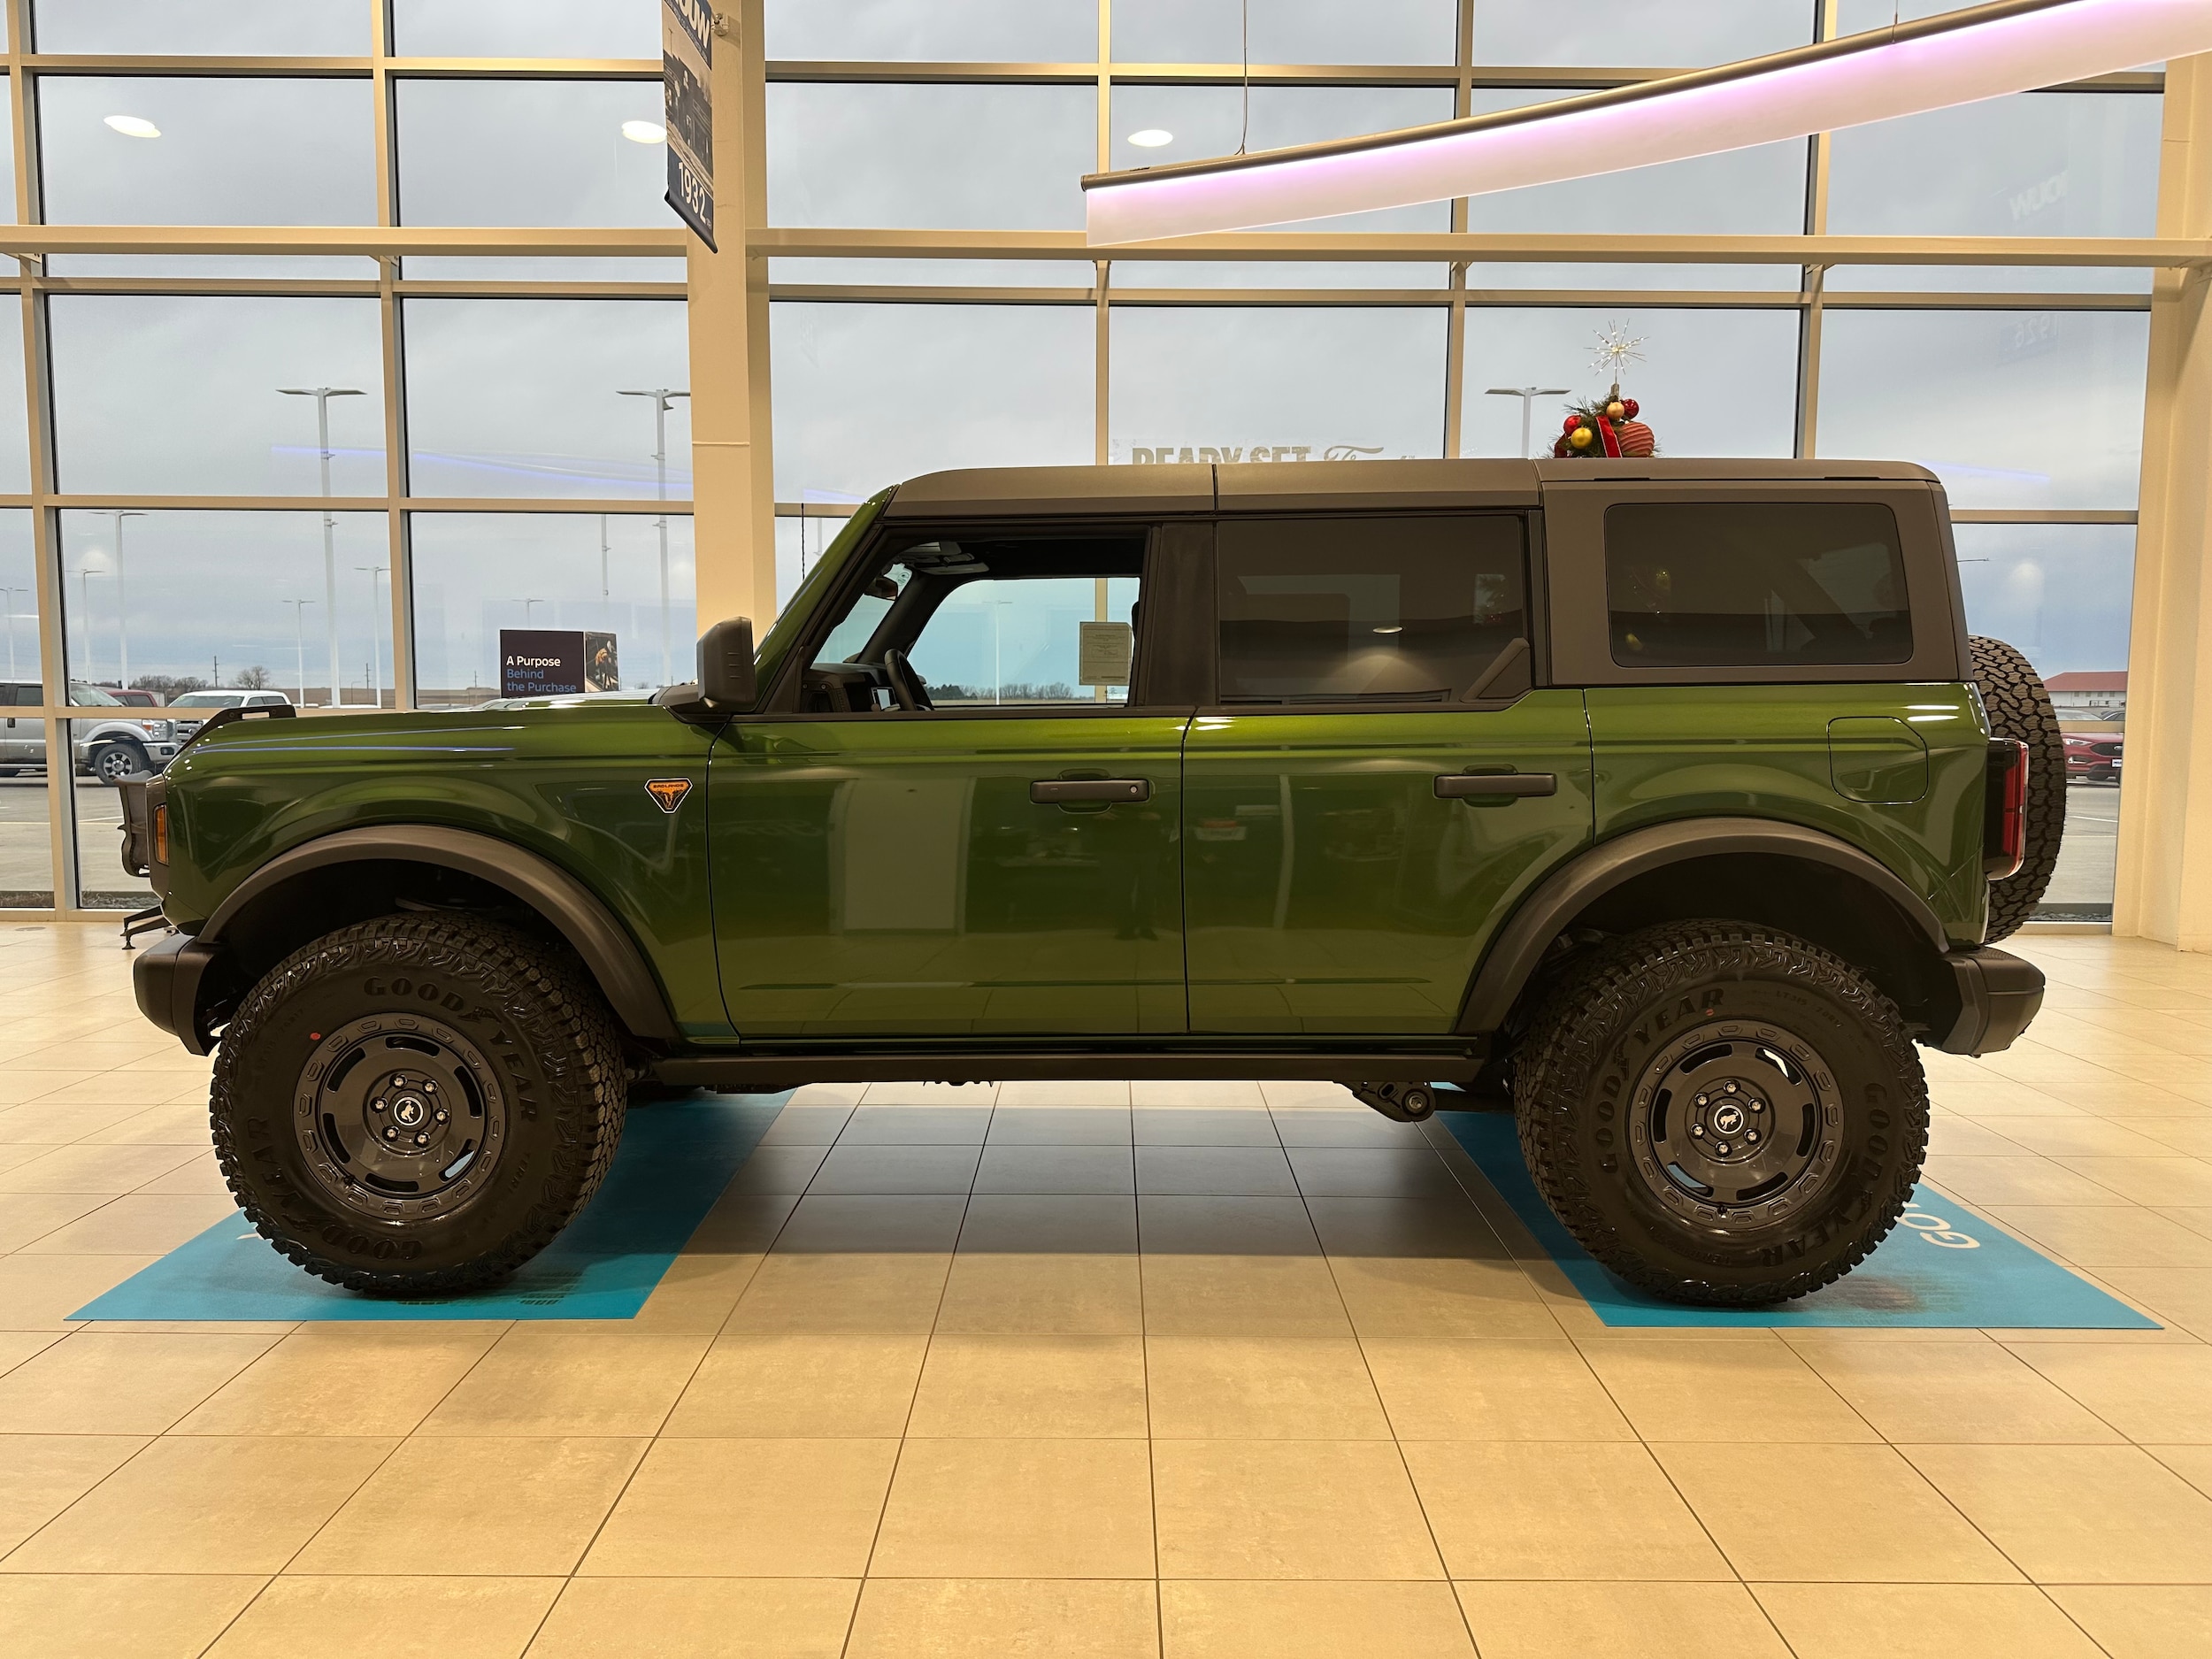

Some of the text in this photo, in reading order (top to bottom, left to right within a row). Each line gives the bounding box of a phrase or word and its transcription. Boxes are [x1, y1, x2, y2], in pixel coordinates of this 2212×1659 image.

[678, 162, 706, 225] 1932
[506, 656, 561, 669] A Purpose
[507, 668, 544, 680] Behind
[507, 682, 577, 694] the Purchase
